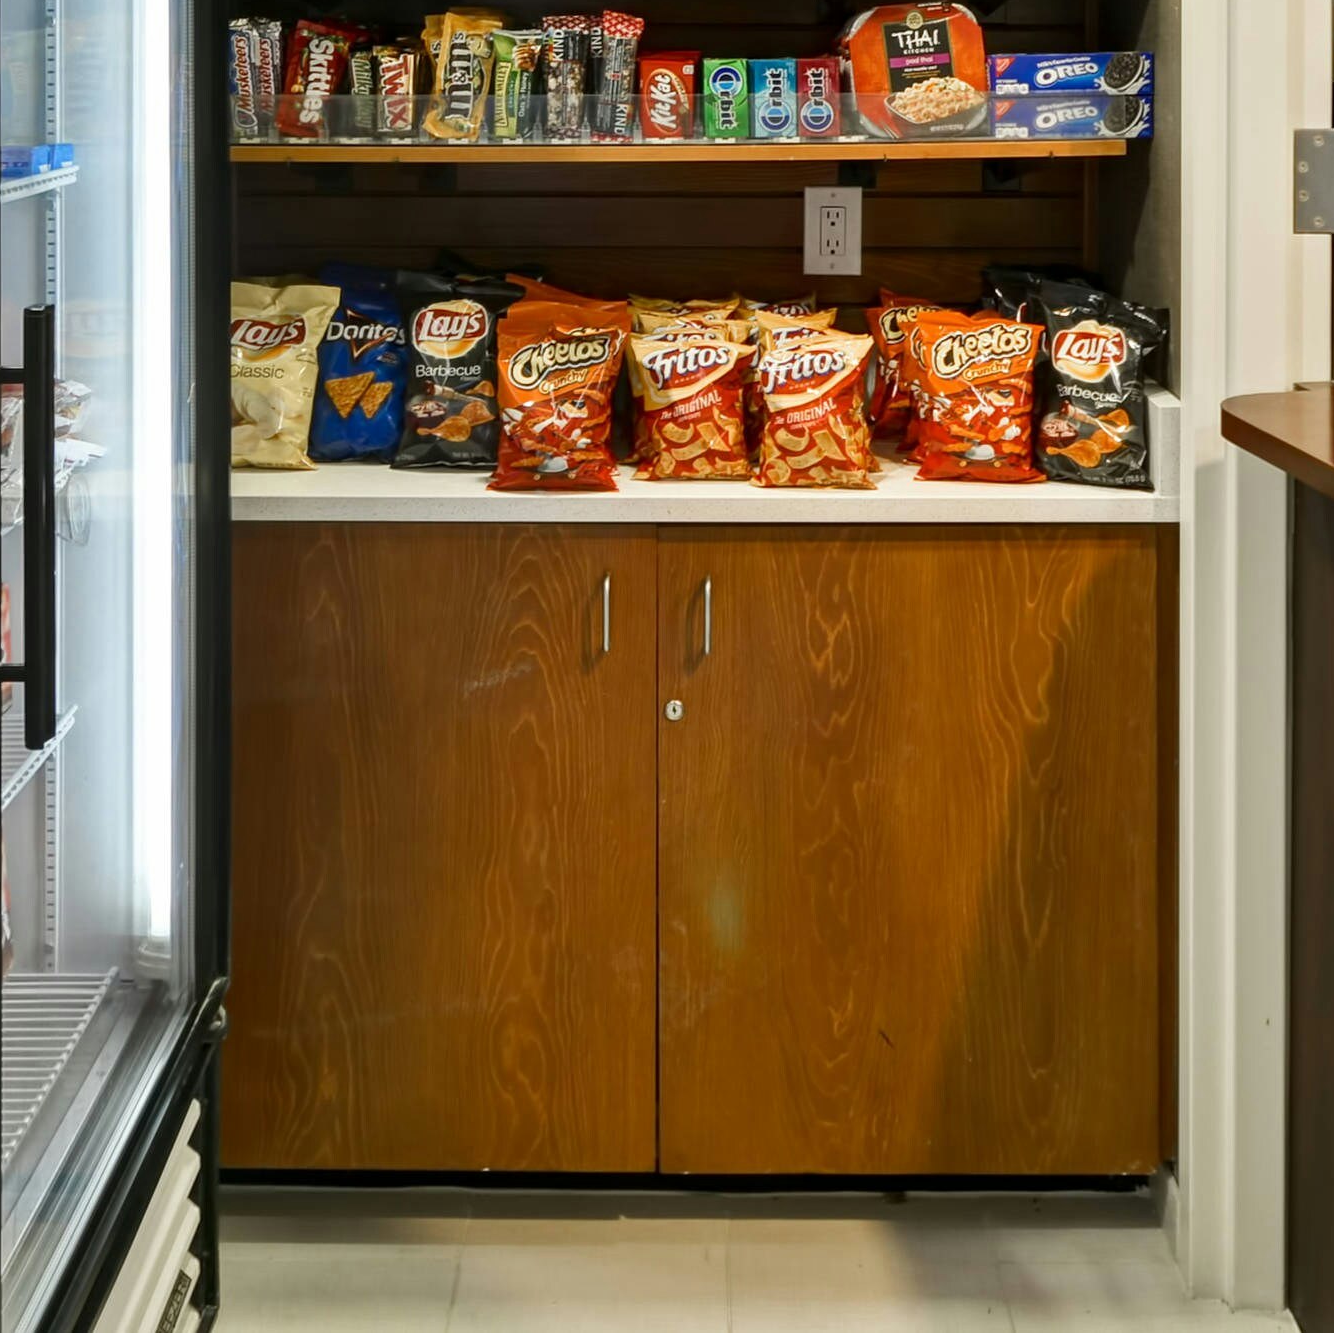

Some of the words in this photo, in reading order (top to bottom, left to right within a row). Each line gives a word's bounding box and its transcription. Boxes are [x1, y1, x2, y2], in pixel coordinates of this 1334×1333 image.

[552, 29, 565, 61] KIND
[591, 26, 603, 58] KIND
[891, 29, 940, 50] THAI
[234, 35, 255, 113] Musketeers
[905, 57, 919, 66] pad
[920, 55, 934, 64] thai
[1034, 61, 1100, 88] OREO
[298, 37, 336, 125] Skittles
[379, 53, 411, 131] TWIX
[614, 103, 627, 135] KIND
[1033, 105, 1099, 130] OREO
[326, 321, 406, 346] Doritos
[510, 337, 610, 390] Cheetos
[933, 324, 1032, 378] Cheetos
[415, 364, 482, 378] Barbecue
[538, 368, 587, 396] Crunchy
[642, 344, 732, 390] Fritos
[761, 348, 846, 395] Fritos
[963, 359, 1013, 381] Crunchy
[673, 390, 722, 418] ORIGINAL
[786, 399, 836, 426] ORIGINAL
